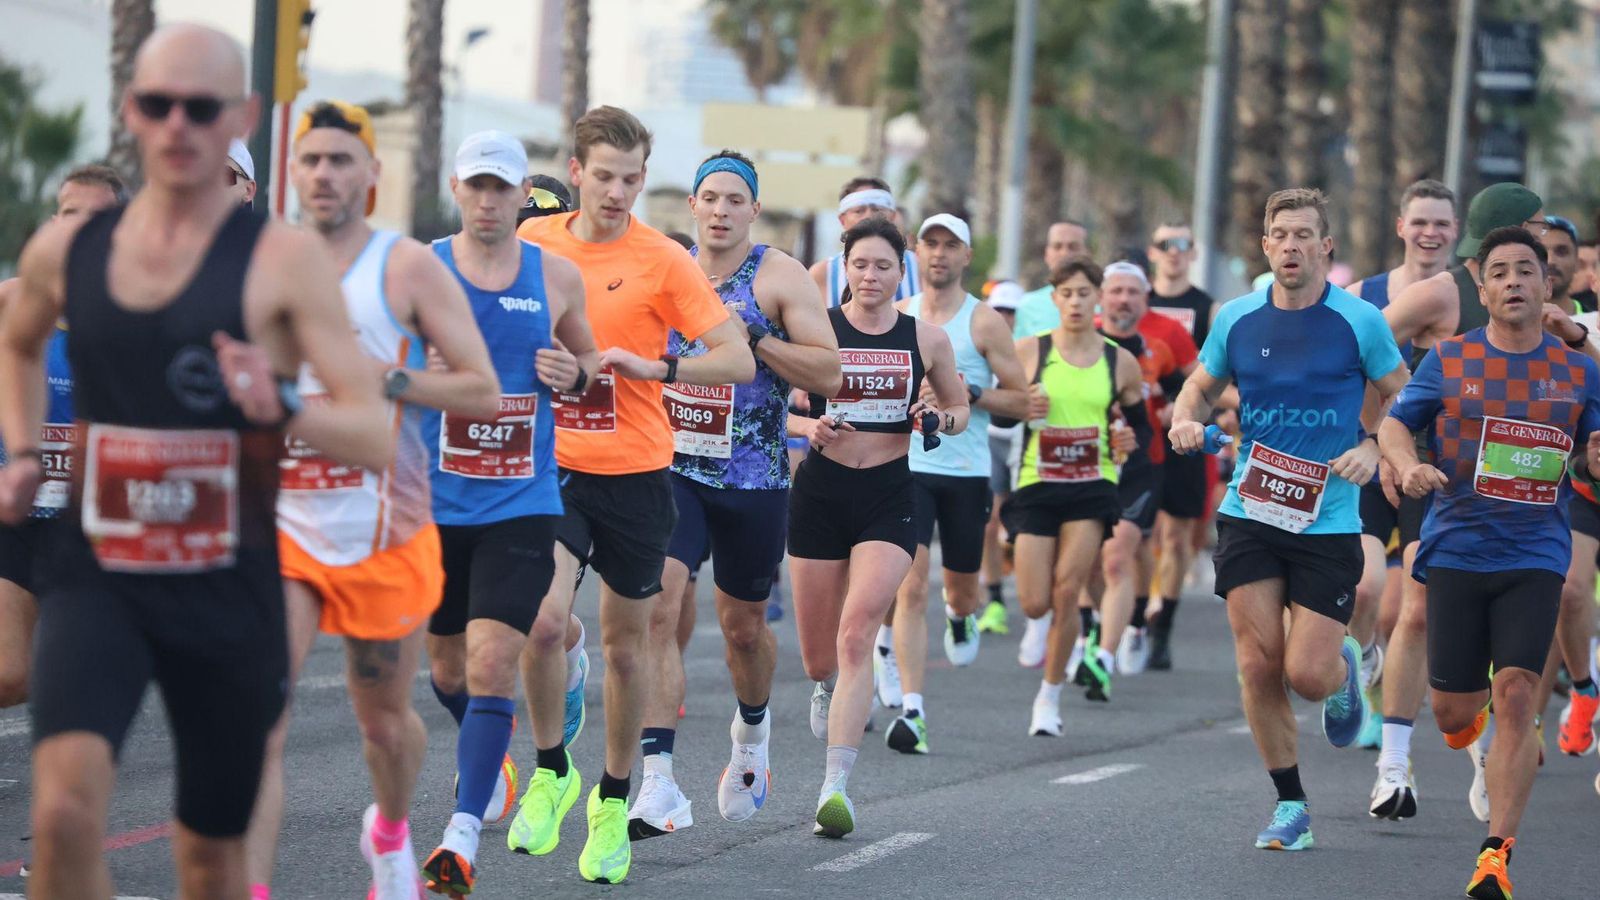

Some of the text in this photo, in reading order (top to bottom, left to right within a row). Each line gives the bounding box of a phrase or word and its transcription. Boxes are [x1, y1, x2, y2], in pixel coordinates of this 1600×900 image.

[498, 296, 541, 312] sparta
[851, 353, 904, 364] GENERALI
[676, 382, 727, 399] GENERALI
[847, 376, 895, 390] 11524
[670, 402, 713, 424] 13069
[467, 423, 514, 441] 6247
[1510, 425, 1567, 446] GENERALI
[1270, 454, 1323, 478] GENERALI
[1510, 451, 1542, 469] 482
[1260, 474, 1306, 500] 14870
